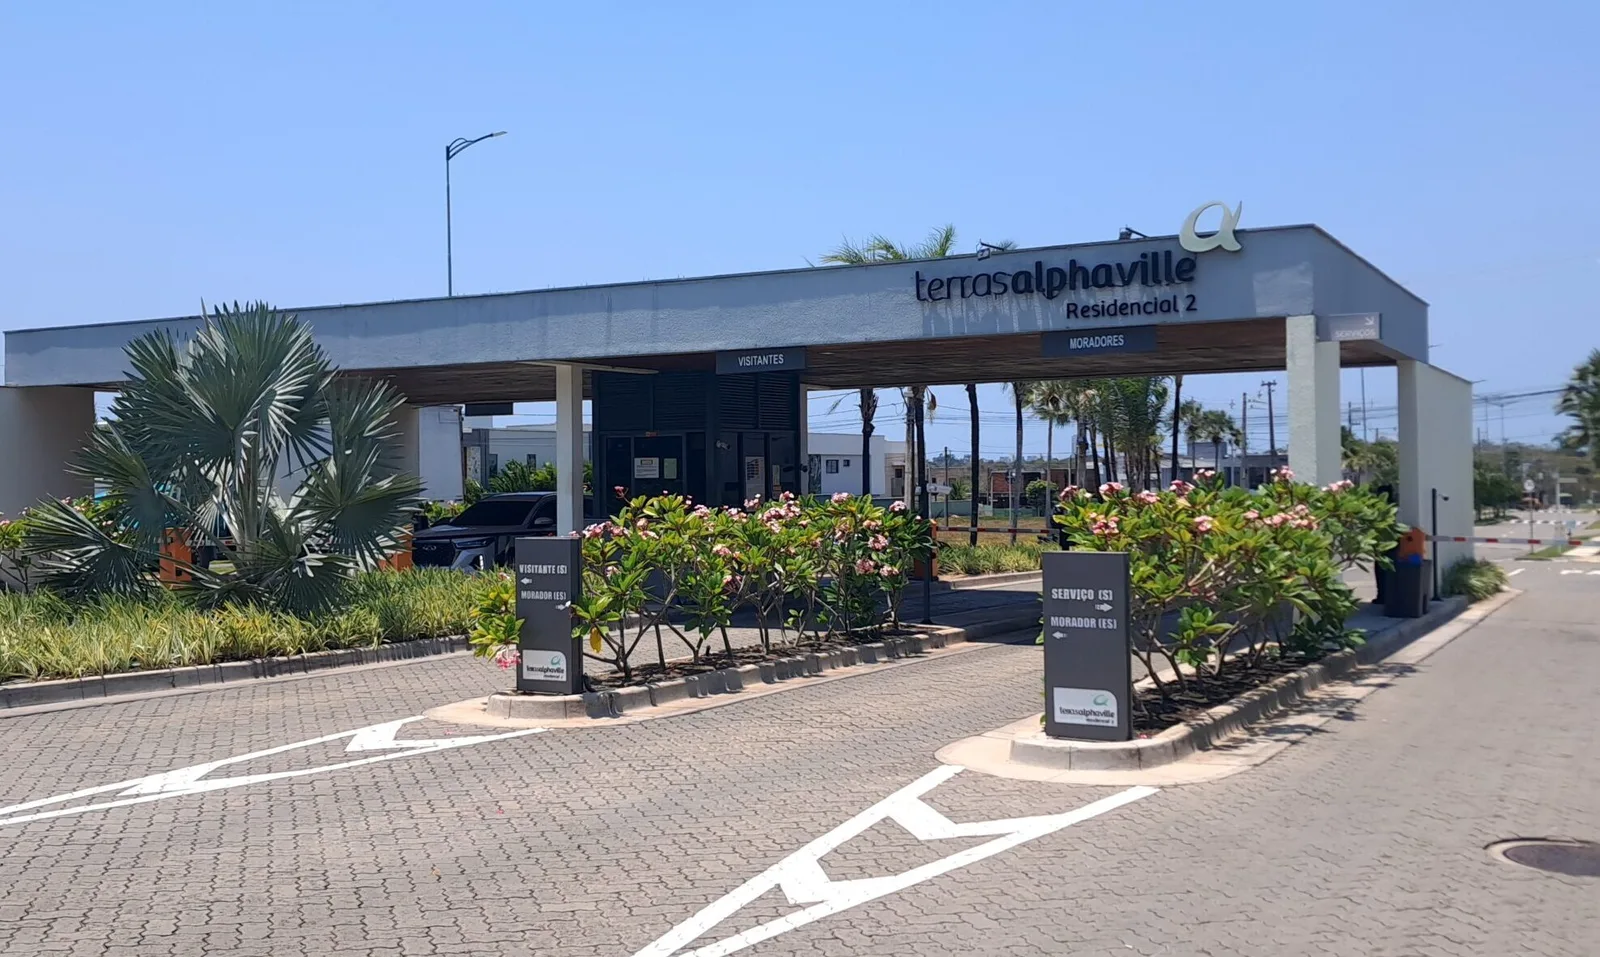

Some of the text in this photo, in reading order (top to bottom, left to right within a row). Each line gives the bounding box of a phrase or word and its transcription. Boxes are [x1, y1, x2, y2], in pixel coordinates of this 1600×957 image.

[915, 250, 1197, 302] terrasalphaville
[1066, 294, 1198, 319] Residencial 2
[1069, 334, 1125, 350] MORADORES
[738, 354, 784, 367] VISITANTES
[519, 564, 567, 575] VISITANTE (S)
[520, 590, 567, 600] MORADOR (ES)
[1051, 588, 1113, 602] SERVIÇO (S)
[1050, 616, 1117, 630] MORADOR (ES)
